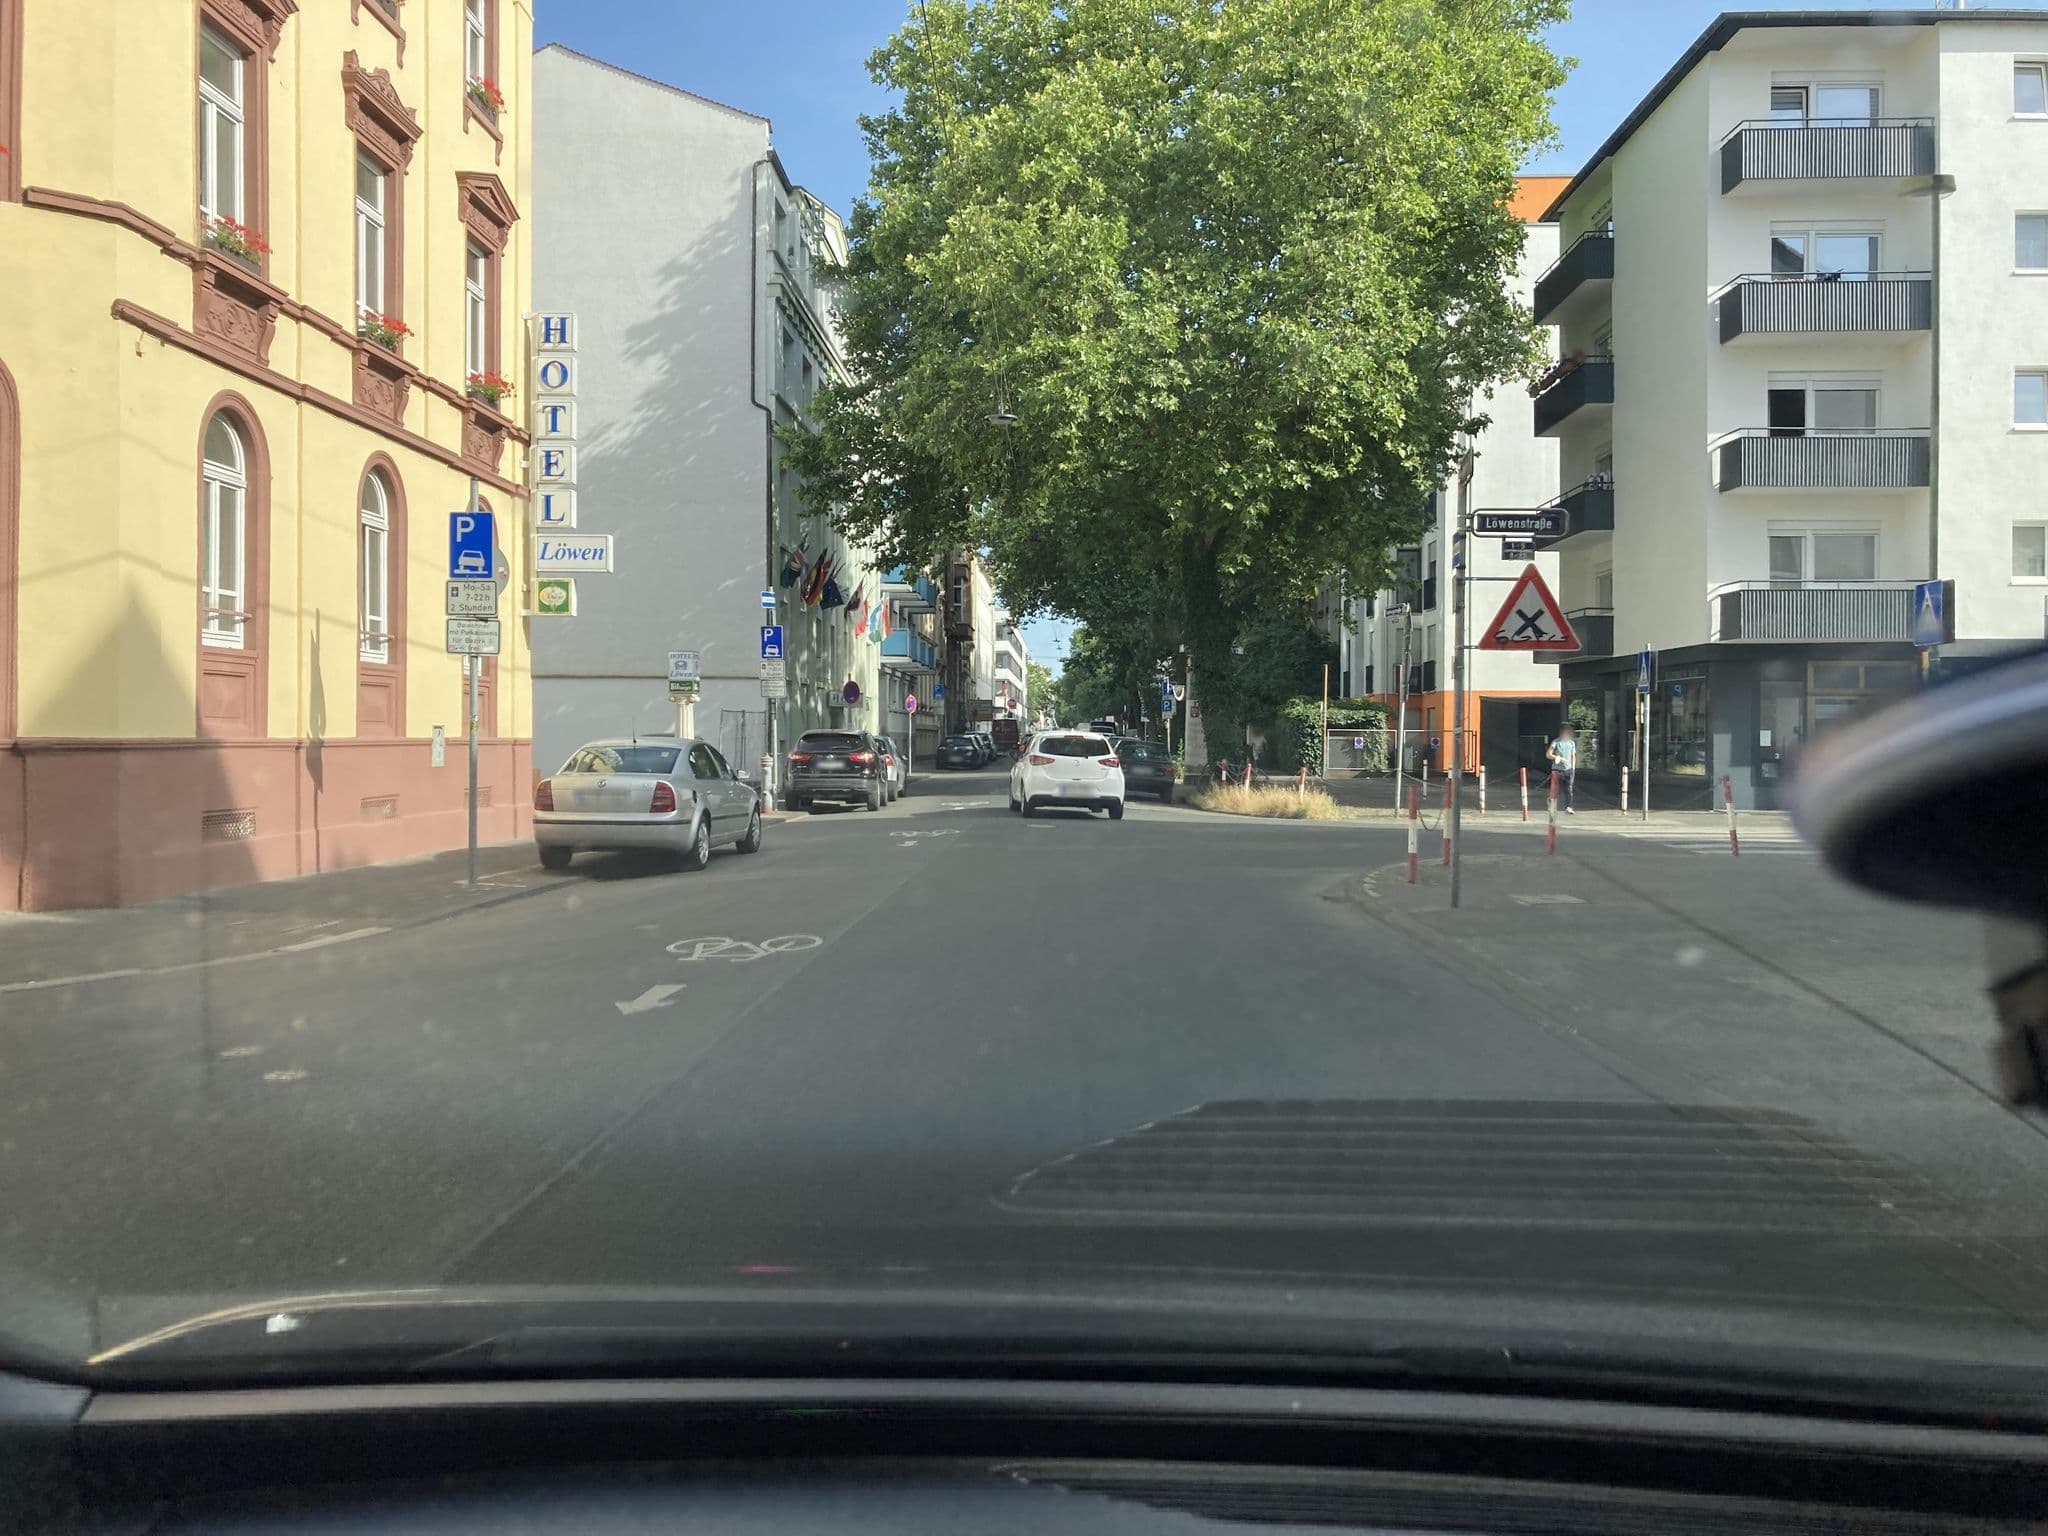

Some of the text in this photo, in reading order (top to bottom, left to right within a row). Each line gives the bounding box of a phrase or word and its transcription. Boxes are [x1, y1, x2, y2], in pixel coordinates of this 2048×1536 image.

[540, 316, 569, 522] HOTEL
[456, 516, 475, 543] P
[1486, 516, 1552, 531] Löwenstraße
[540, 542, 605, 561] Löwen
[450, 603, 493, 612] 2 Stunden
[764, 628, 774, 642] P
